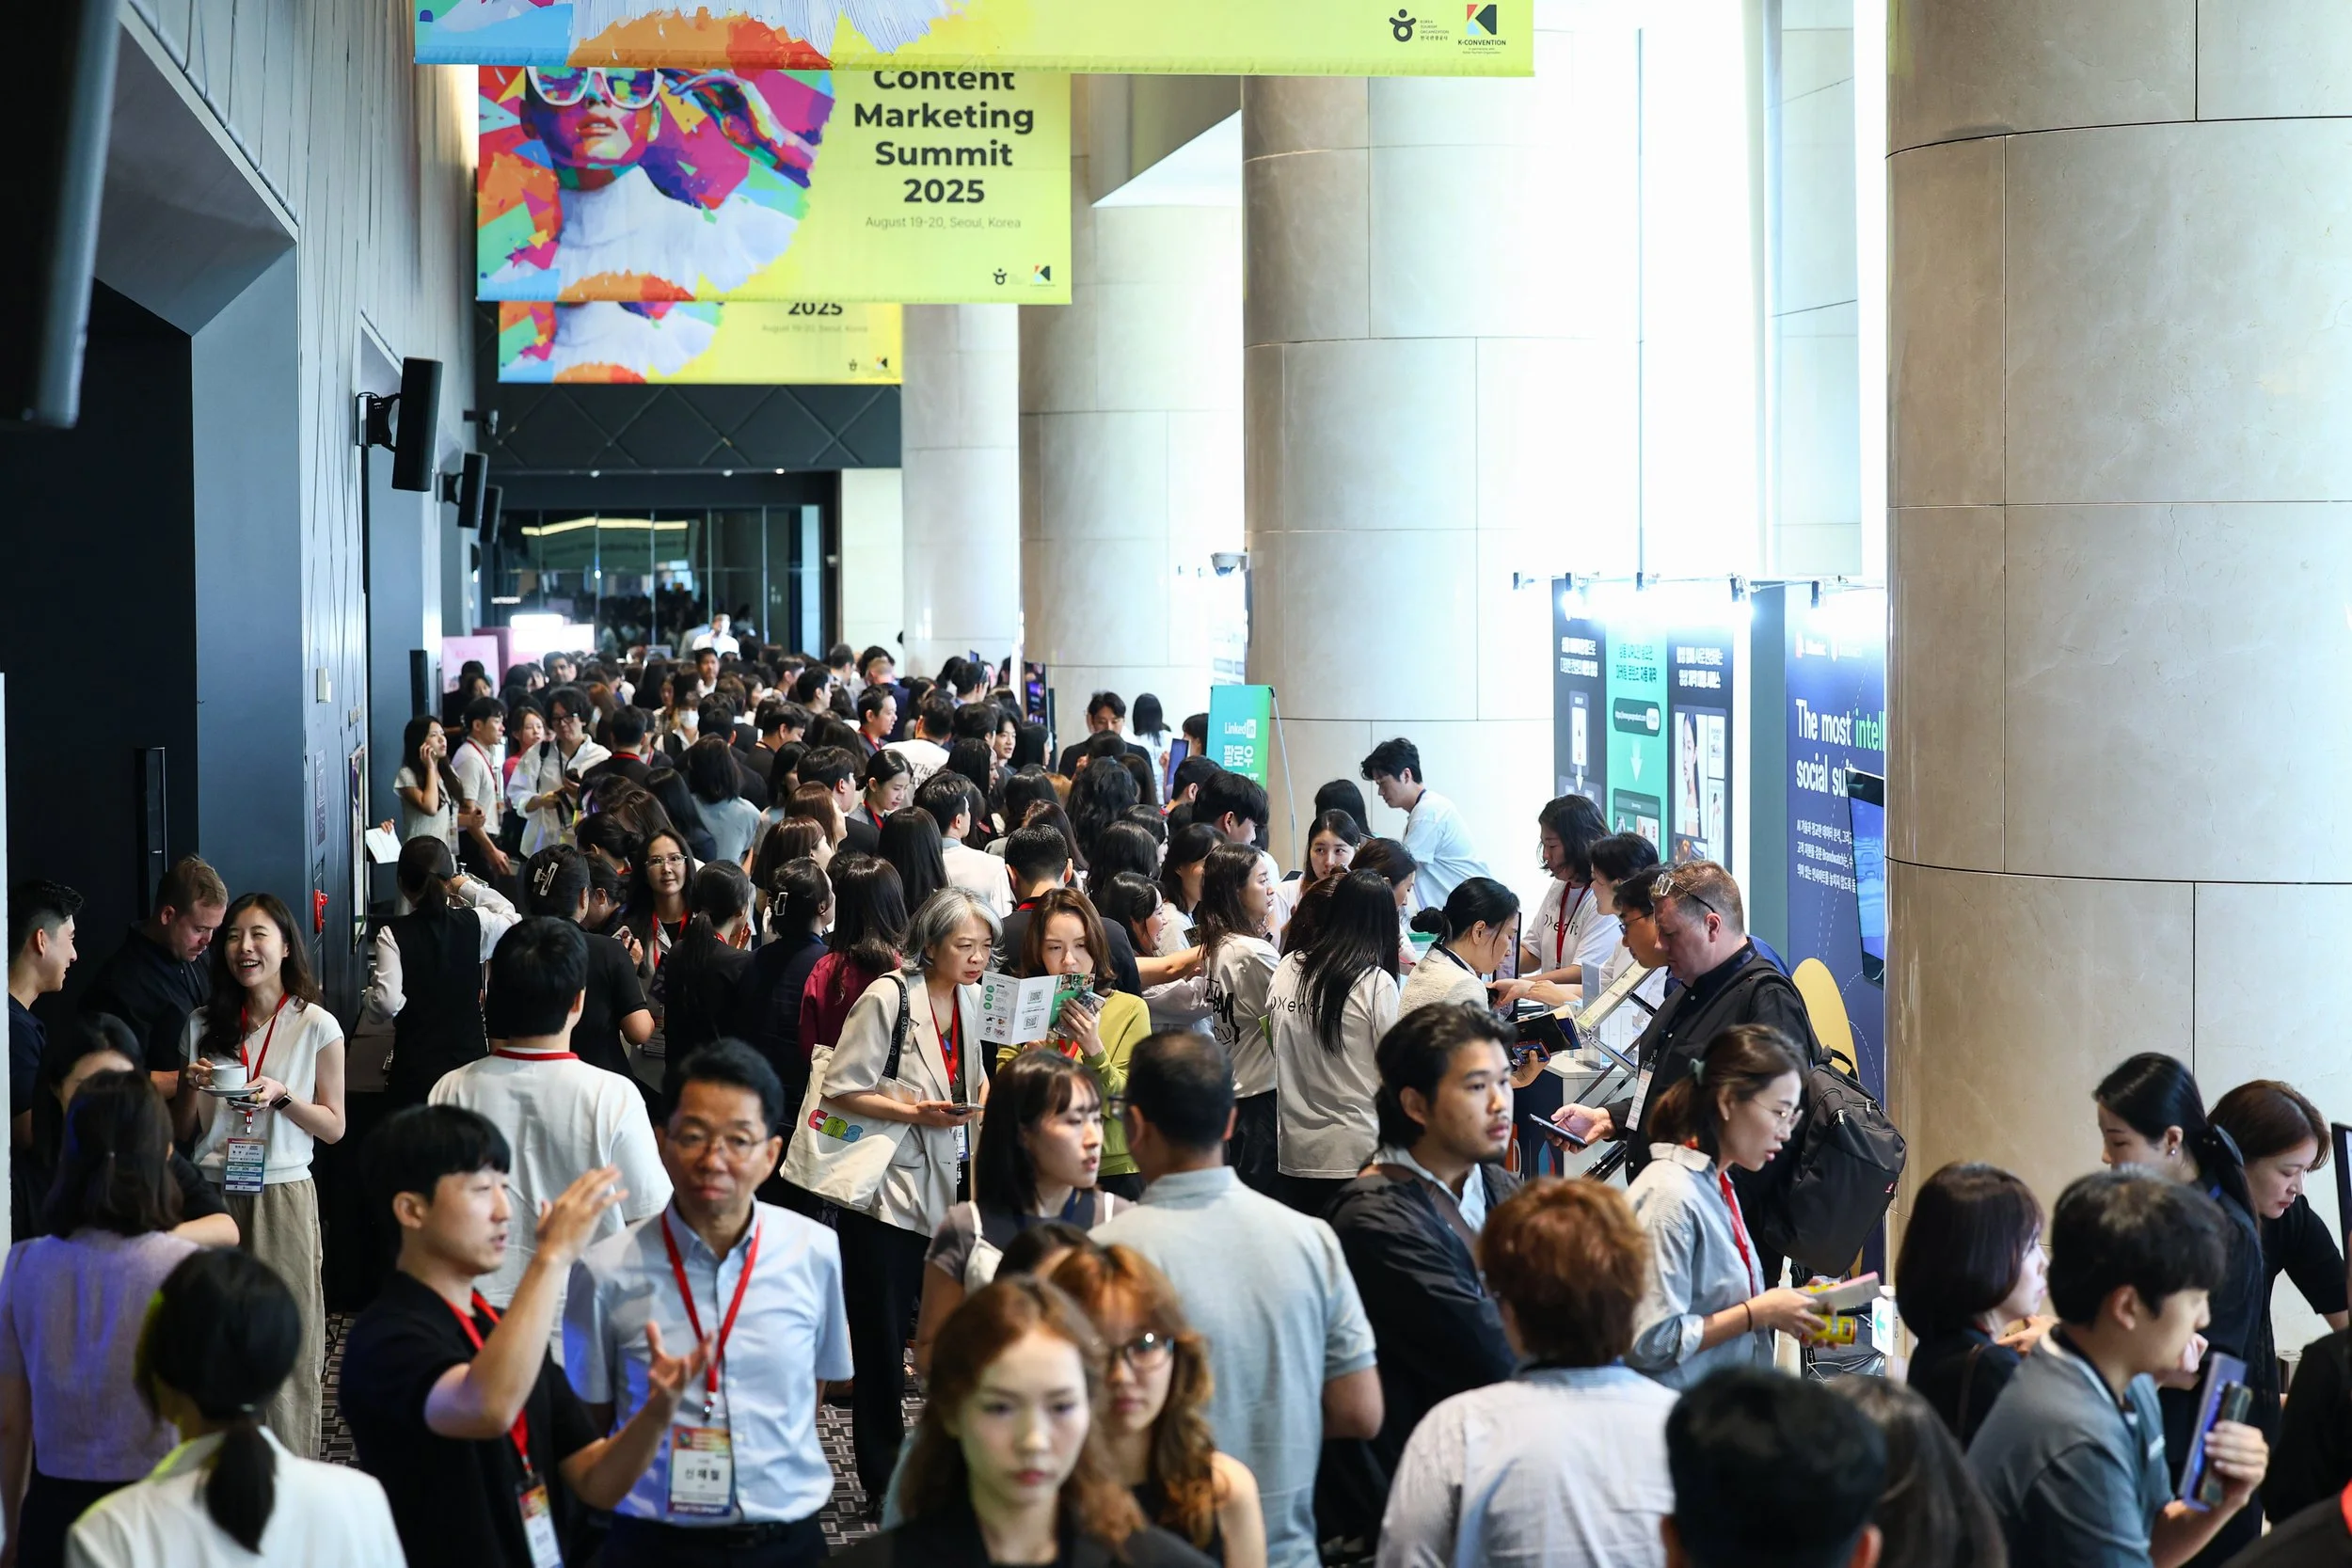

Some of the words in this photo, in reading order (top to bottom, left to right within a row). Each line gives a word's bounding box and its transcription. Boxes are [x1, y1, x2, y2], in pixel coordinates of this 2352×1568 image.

[874, 71, 1016, 90] Content
[854, 102, 1034, 135] Marketing
[875, 139, 1013, 166] Summit
[903, 179, 985, 203] 2025
[866, 216, 906, 230] August
[911, 216, 946, 230] 19-20,
[950, 216, 984, 229] Seoul,
[989, 217, 1021, 229] Korea
[788, 303, 843, 315] 2025
[1795, 698, 1819, 740] The
[1821, 710, 1851, 746] most
[1224, 745, 1254, 768] 팔로우
[1796, 752, 1829, 794] social
